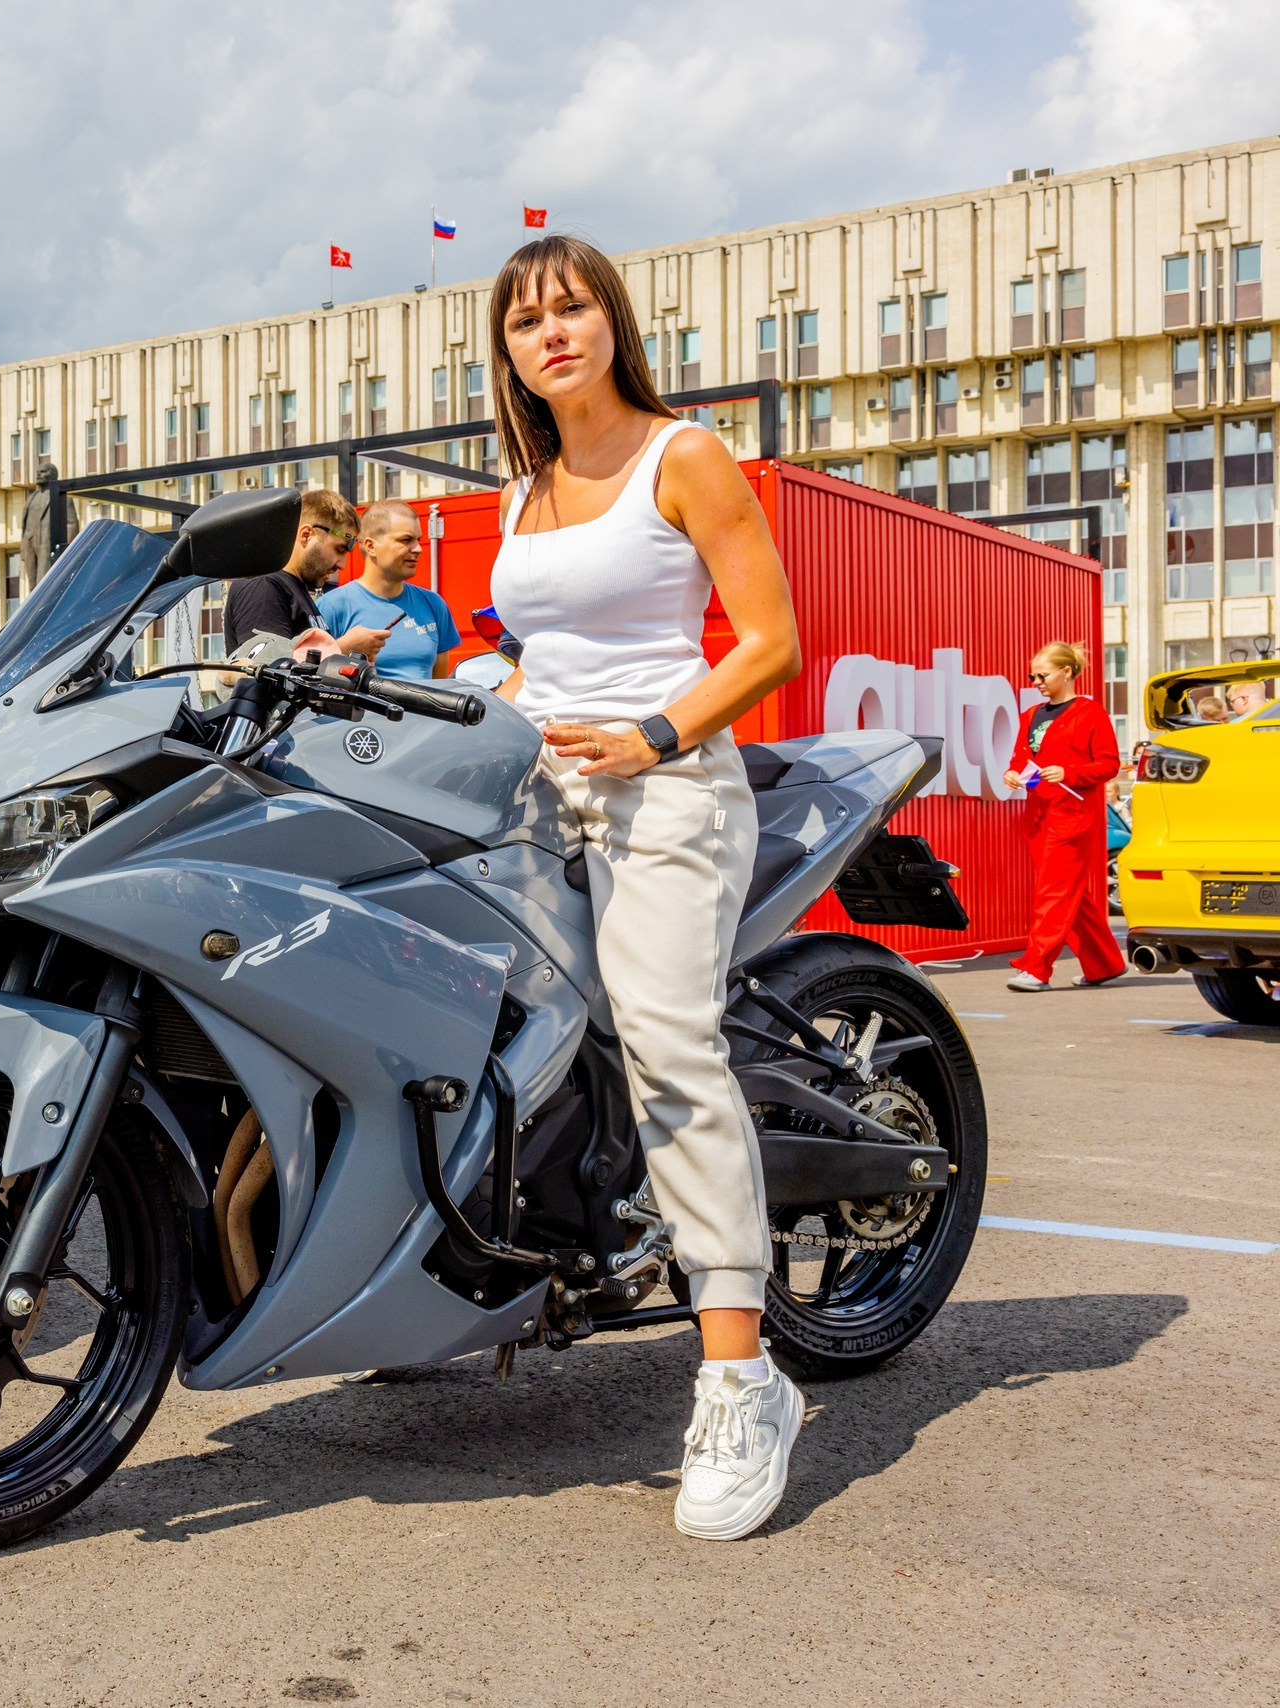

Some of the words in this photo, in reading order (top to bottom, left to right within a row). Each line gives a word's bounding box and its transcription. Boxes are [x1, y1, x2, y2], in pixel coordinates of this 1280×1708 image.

[221, 909, 331, 981] R3
[814, 973, 880, 996] MICHELIN
[843, 1320, 904, 1351] MICHELIN
